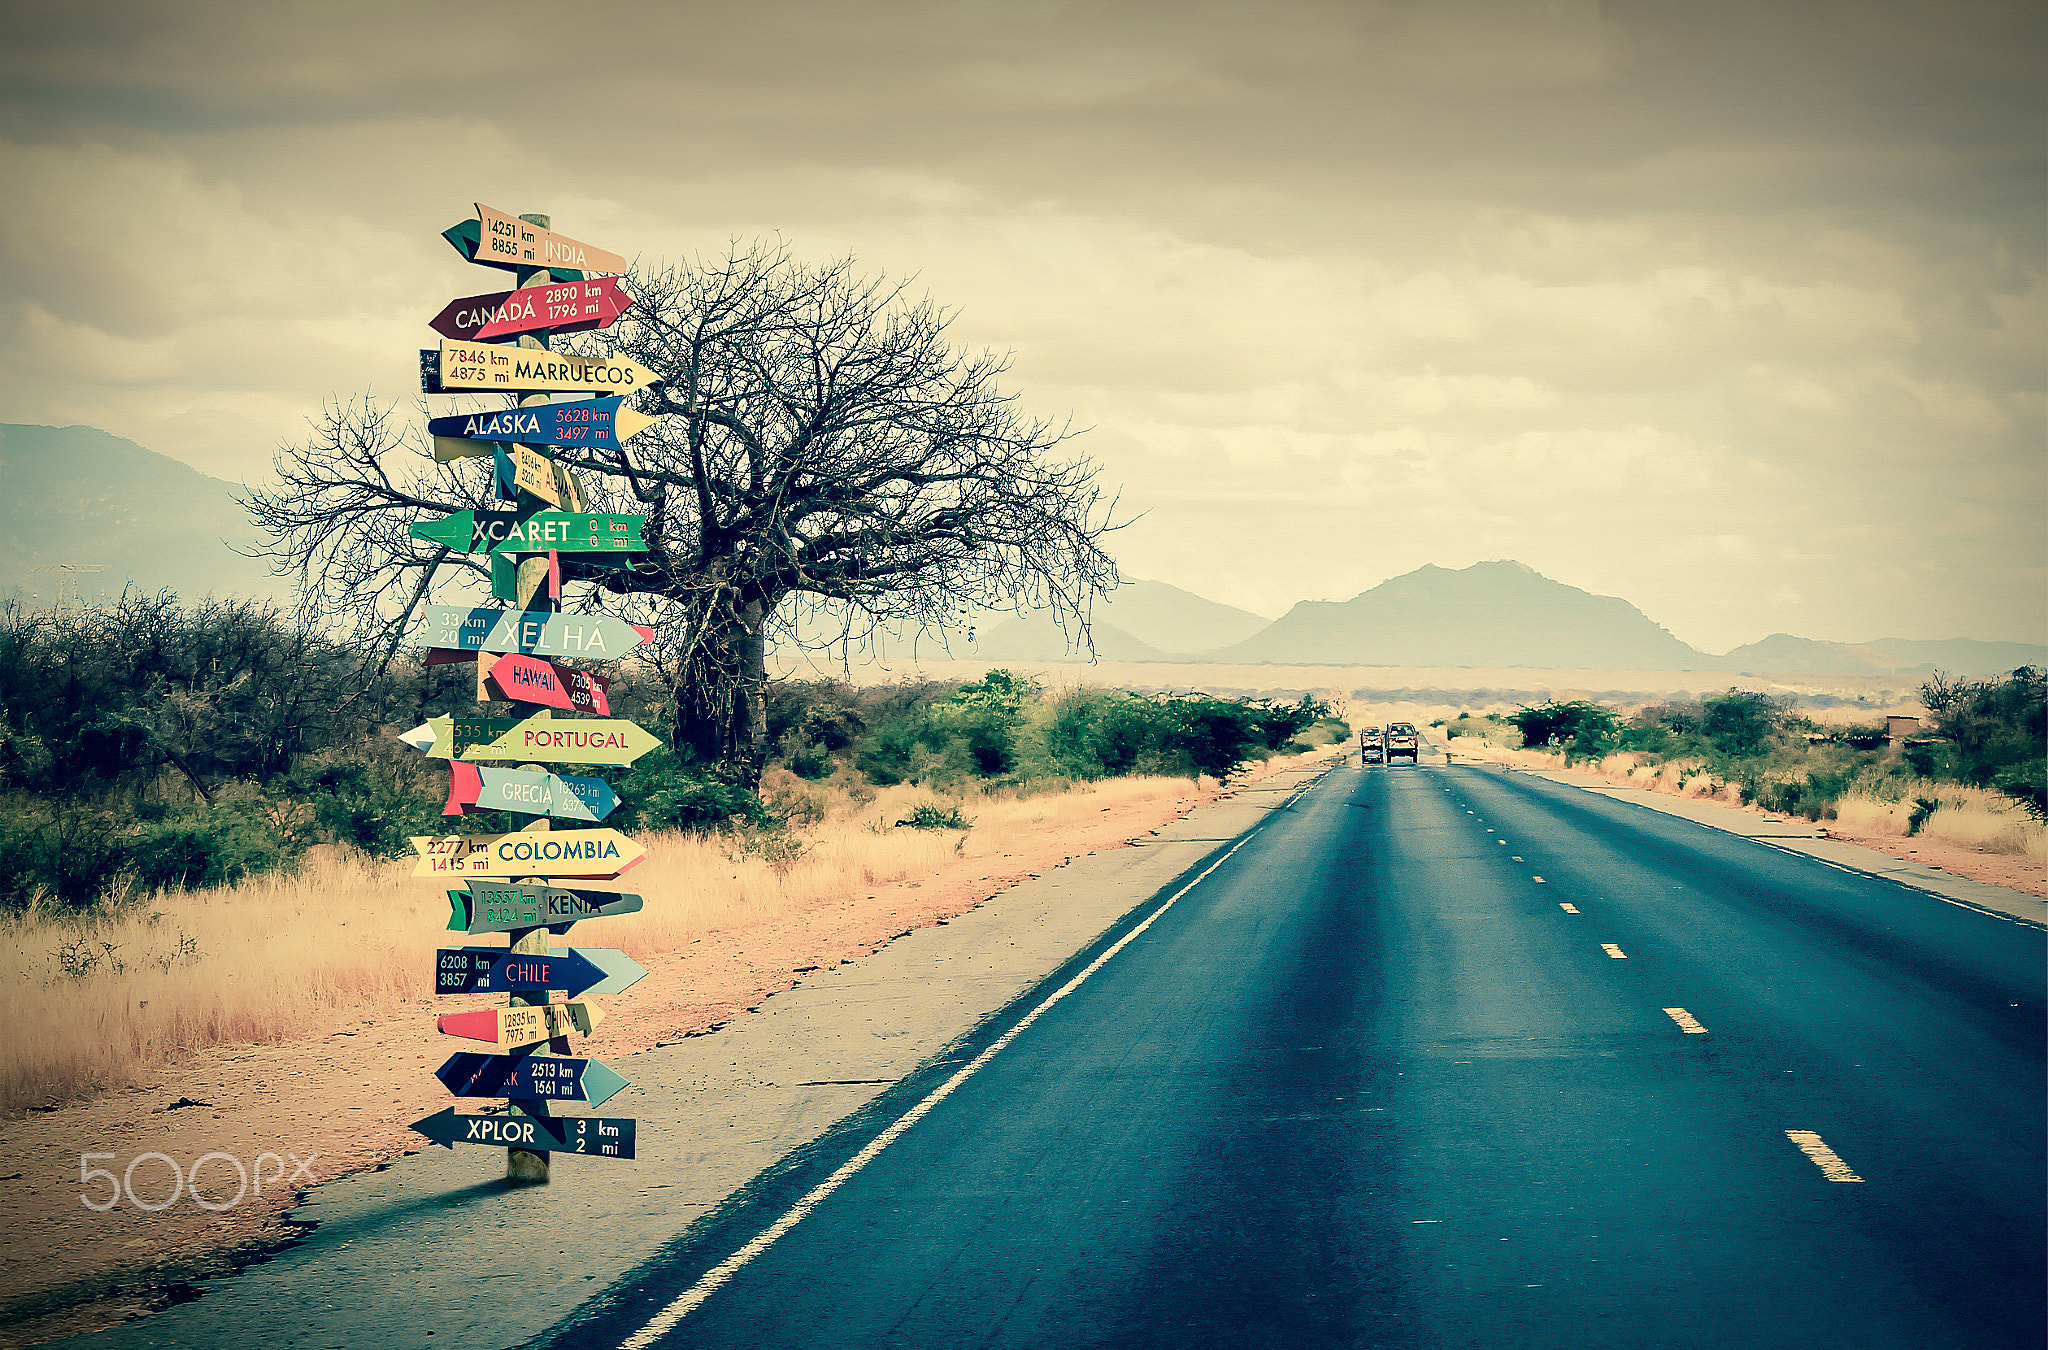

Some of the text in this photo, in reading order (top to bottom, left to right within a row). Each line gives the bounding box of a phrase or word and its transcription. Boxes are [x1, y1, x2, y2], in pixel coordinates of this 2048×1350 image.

[487, 218, 535, 243] 14251 km
[491, 237, 535, 261] 8855 mi
[545, 239, 587, 267] INDIA
[545, 284, 602, 303] 2890 km
[455, 295, 536, 329] CANADÁ
[548, 300, 599, 320] 1796 mi
[449, 349, 509, 366] 7846 km
[449, 366, 510, 383] 4875 mi
[515, 360, 634, 385] MARRUECOS
[555, 407, 610, 423] 5628 km
[463, 413, 541, 435] ALASKA
[555, 426, 610, 440] 3497 mi
[472, 520, 571, 541] XCARET
[589, 517, 628, 531] 0 km
[613, 535, 629, 547] mi
[441, 612, 486, 629] 33 km
[440, 629, 485, 645] 20 mi
[500, 619, 607, 652] XEL HÁ
[513, 665, 556, 692] HAWAII
[571, 674, 604, 694] 7305 km
[571, 690, 601, 710] 4539 mi
[444, 723, 508, 739] 7535 km
[524, 730, 629, 749] PORTUGAL
[443, 740, 507, 755] 4682 mi
[502, 782, 553, 804] GRECIA
[558, 781, 600, 798] 10263 km
[562, 798, 600, 814] 6377 mi
[426, 839, 489, 855] 2277 km
[498, 839, 620, 862] COLOMBIA
[431, 857, 489, 872] 1415 mi
[480, 890, 537, 906] 13557 km
[548, 894, 602, 915] KENIA
[487, 908, 537, 923] 8424 mi
[440, 955, 490, 970] 6208 km
[439, 973, 490, 988] 3857 mi
[505, 963, 550, 982] CHILE
[504, 1010, 537, 1029] 12835 km
[544, 1008, 579, 1031] CHINA
[505, 1027, 537, 1044] 7975 mi
[531, 1063, 556, 1078] 2513
[558, 1064, 574, 1079] km
[534, 1080, 573, 1096] 1561 mi
[466, 1119, 535, 1143] XPLOR
[576, 1120, 619, 1137] 3 km
[575, 1139, 619, 1156] 2 mi
